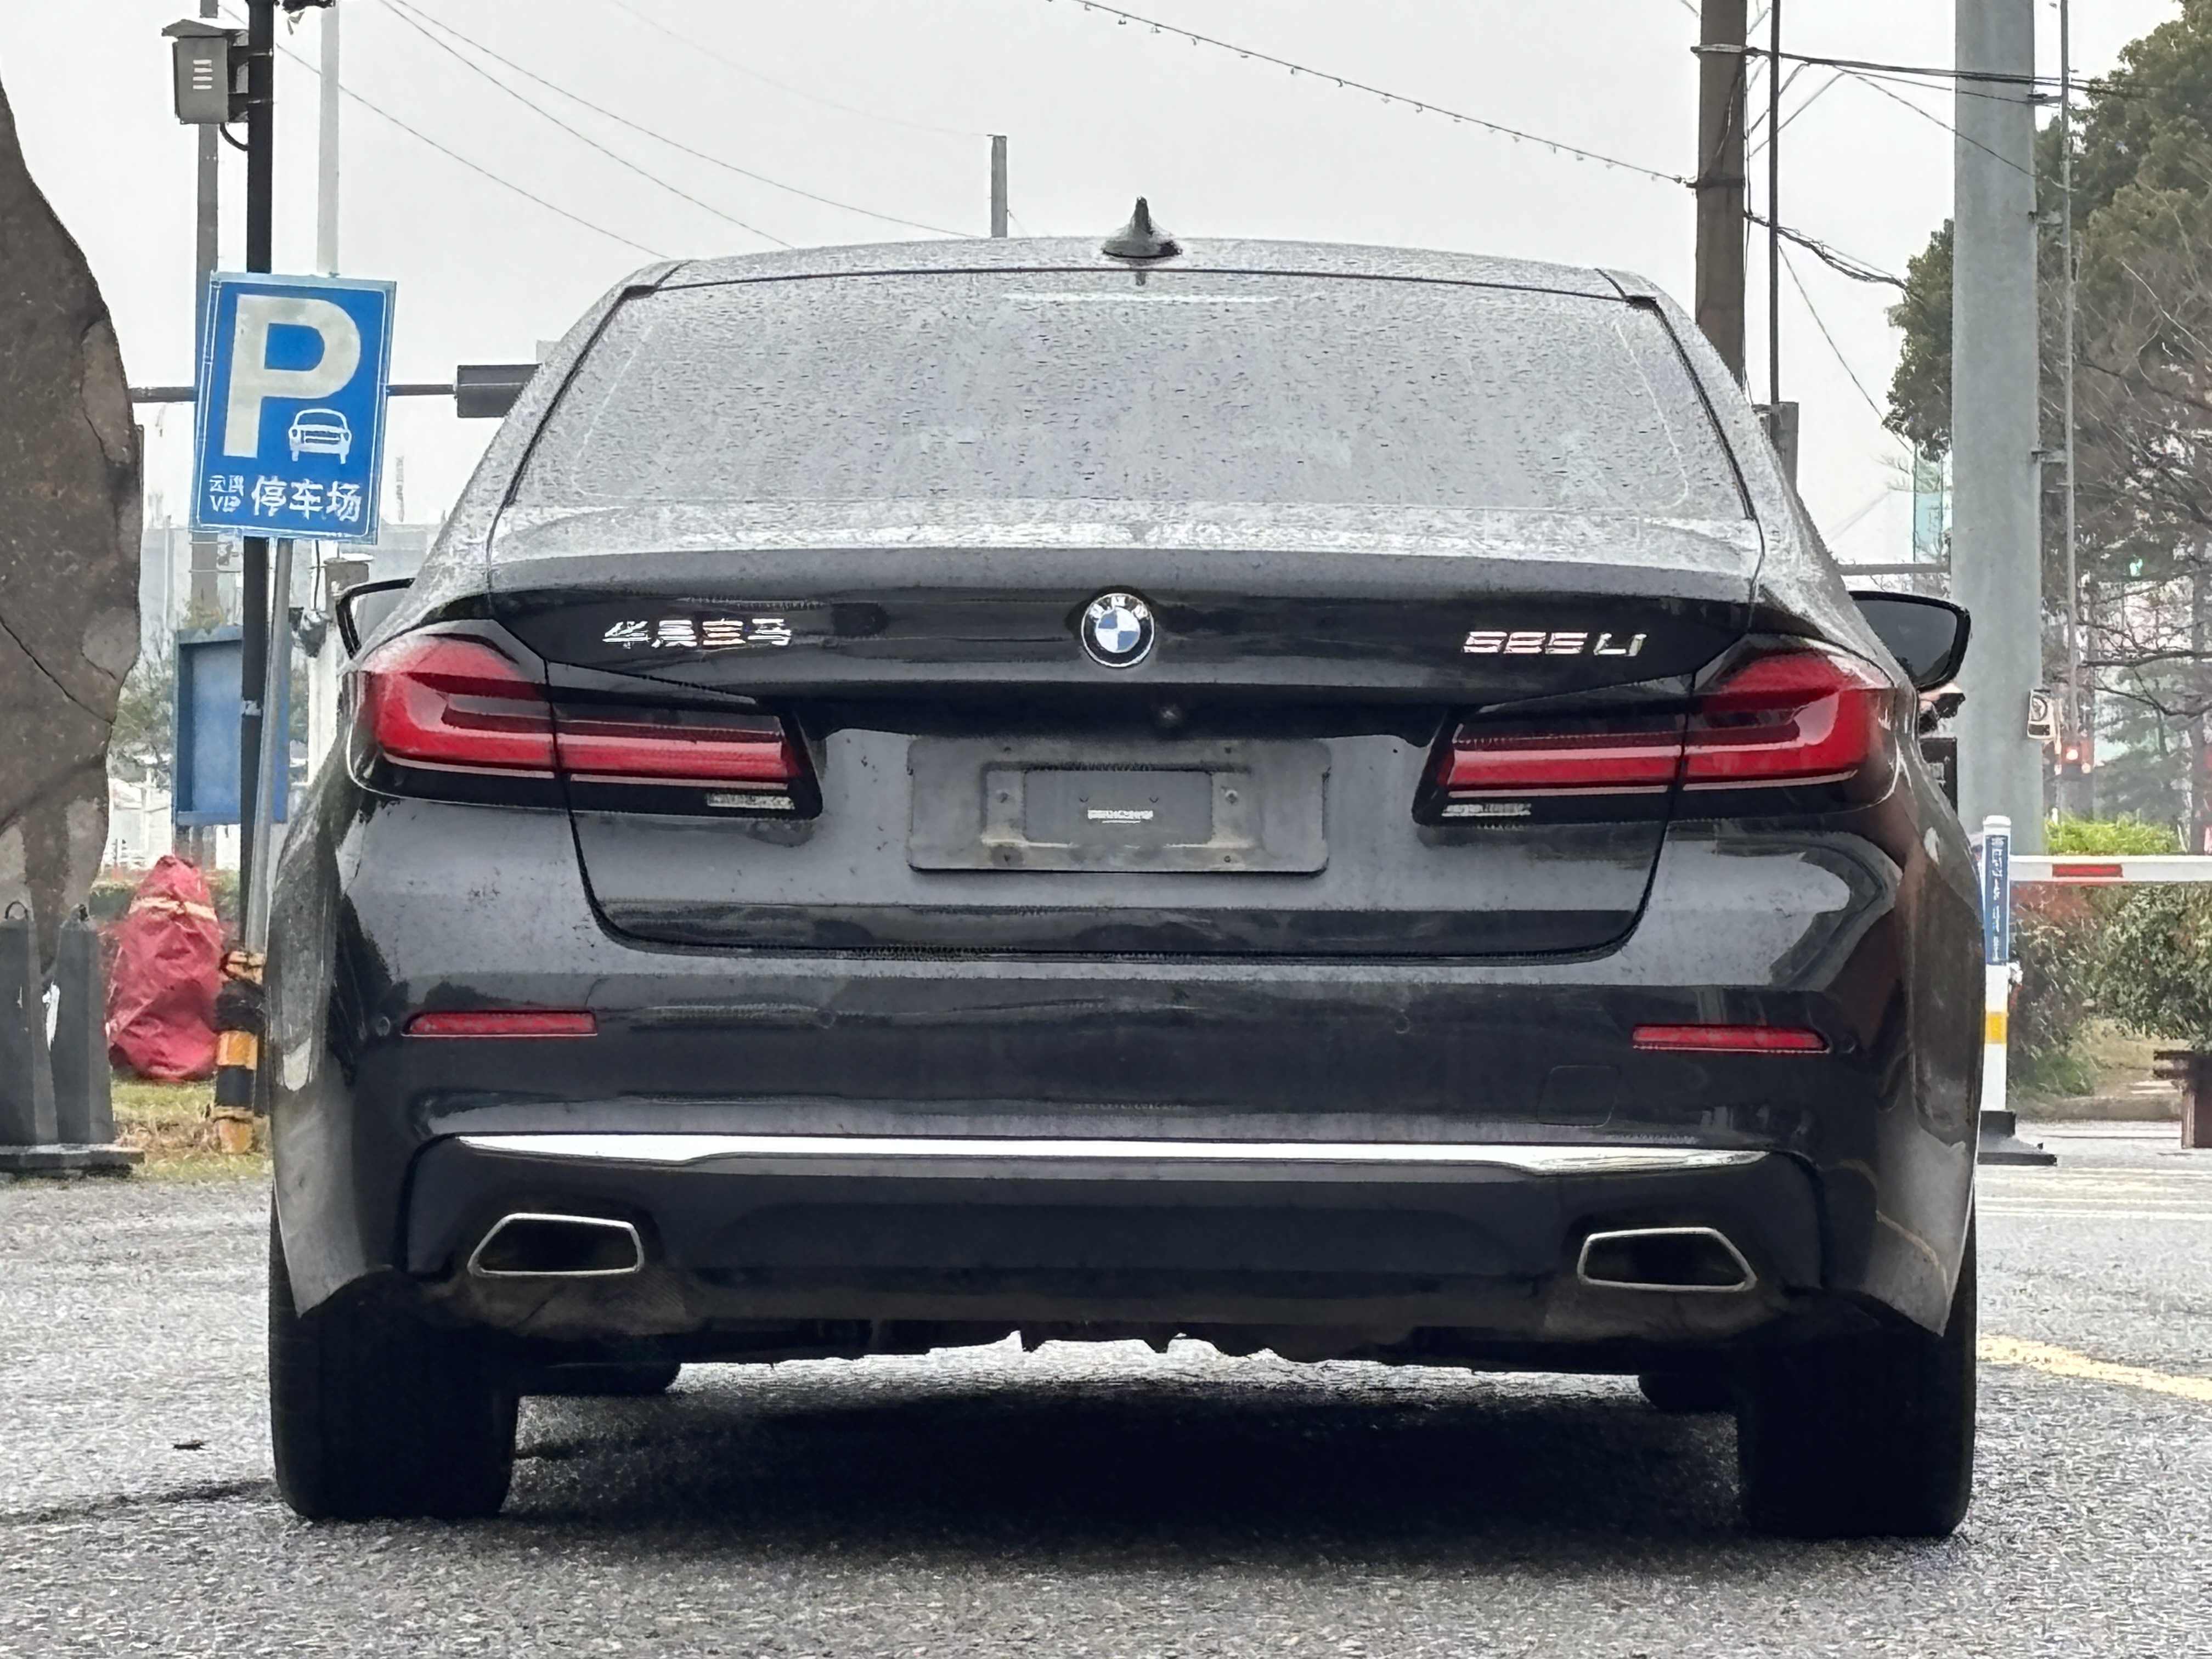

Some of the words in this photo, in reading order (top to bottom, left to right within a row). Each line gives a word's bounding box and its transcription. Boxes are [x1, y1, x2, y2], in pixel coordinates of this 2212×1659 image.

[223, 294, 361, 459] P
[251, 475, 362, 522] 停车场
